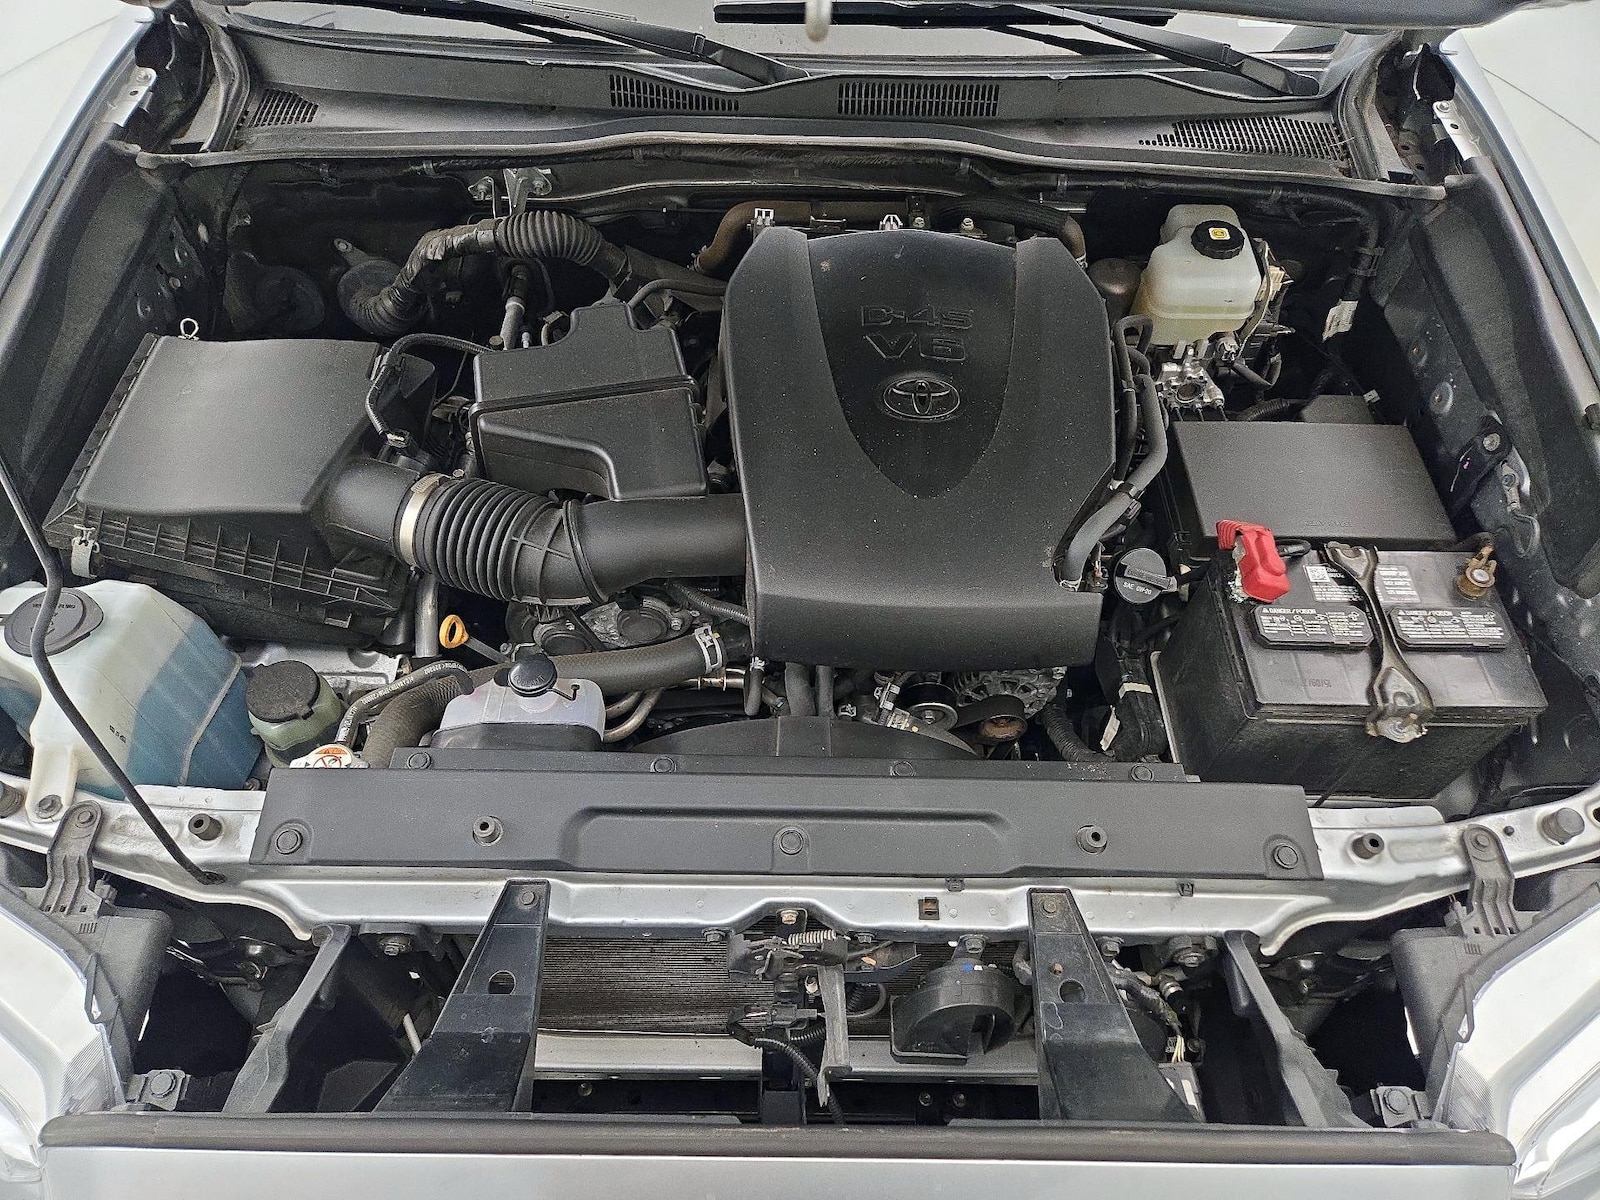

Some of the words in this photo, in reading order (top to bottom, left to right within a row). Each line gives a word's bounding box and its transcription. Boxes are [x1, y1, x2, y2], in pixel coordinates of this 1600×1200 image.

[861, 304, 974, 330] D-4S
[863, 332, 966, 362] V6
[1123, 582, 1135, 590] SAE
[1136, 585, 1152, 595] 0W-20
